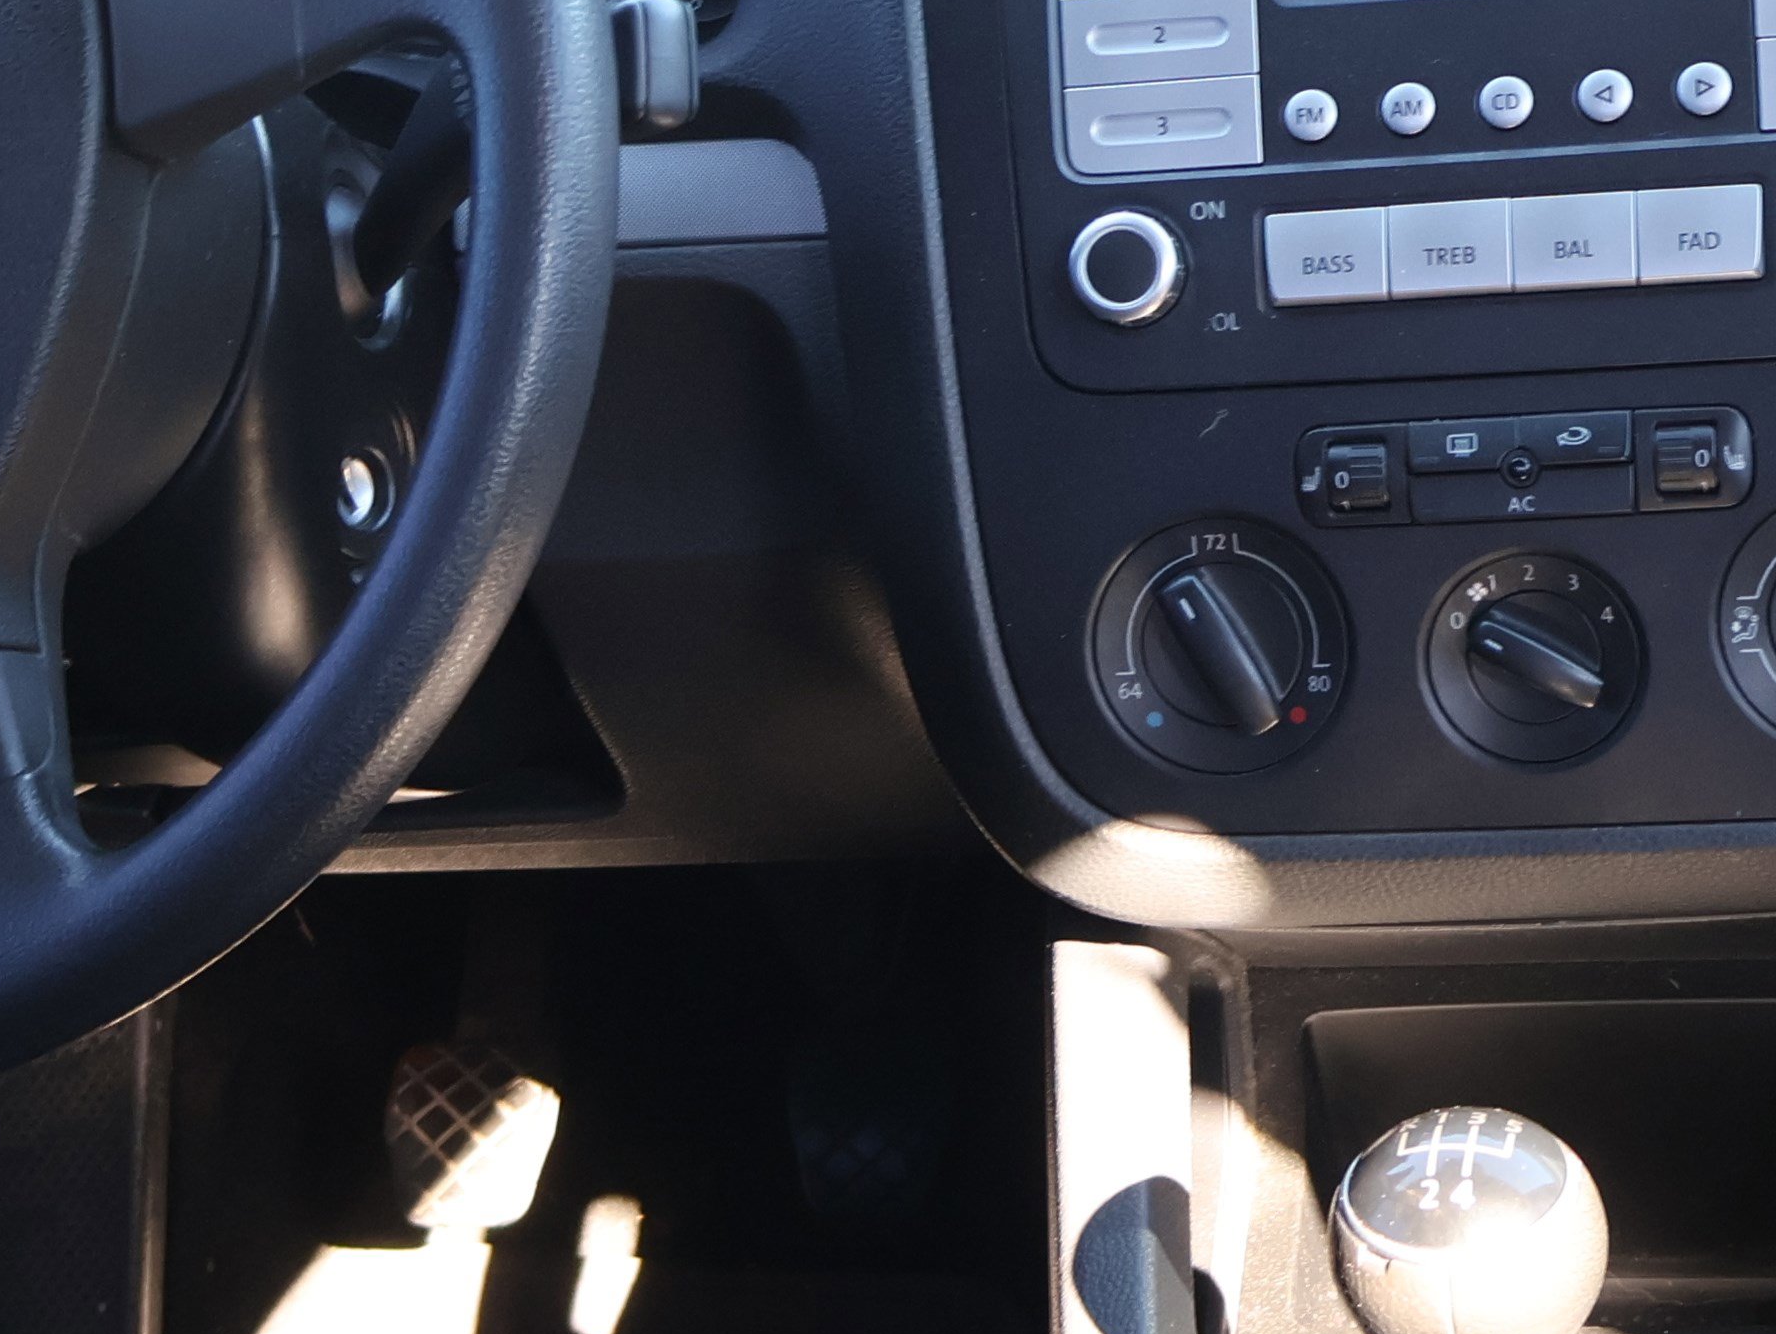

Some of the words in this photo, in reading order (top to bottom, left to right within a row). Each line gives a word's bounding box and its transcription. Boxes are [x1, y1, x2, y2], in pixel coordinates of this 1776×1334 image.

[1153, 26, 1167, 44] 2
[1391, 100, 1423, 118] AM
[1492, 93, 1518, 111] CD
[1296, 107, 1324, 124] FM
[1156, 116, 1169, 135] 3
[1189, 200, 1226, 220] ON
[1553, 240, 1593, 260] BAL
[1678, 231, 1721, 252] FAD
[1423, 246, 1477, 266] TREB
[1301, 255, 1356, 276] BASS
[1204, 312, 1241, 332] OL
[1507, 496, 1536, 513] AC
[1203, 534, 1226, 551] 72
[1523, 564, 1535, 581] 2
[1487, 574, 1497, 591] 1
[1569, 574, 1580, 591] 3
[1450, 612, 1464, 629] 0
[1600, 606, 1615, 624] 4
[1118, 682, 1143, 699] 64
[1307, 675, 1332, 692] 80
[1437, 1111, 1449, 1124] 1
[1467, 1112, 1488, 1125] 3
[1504, 1118, 1524, 1134] 5
[1418, 1178, 1440, 1210] 2
[1449, 1179, 1476, 1211] 4
